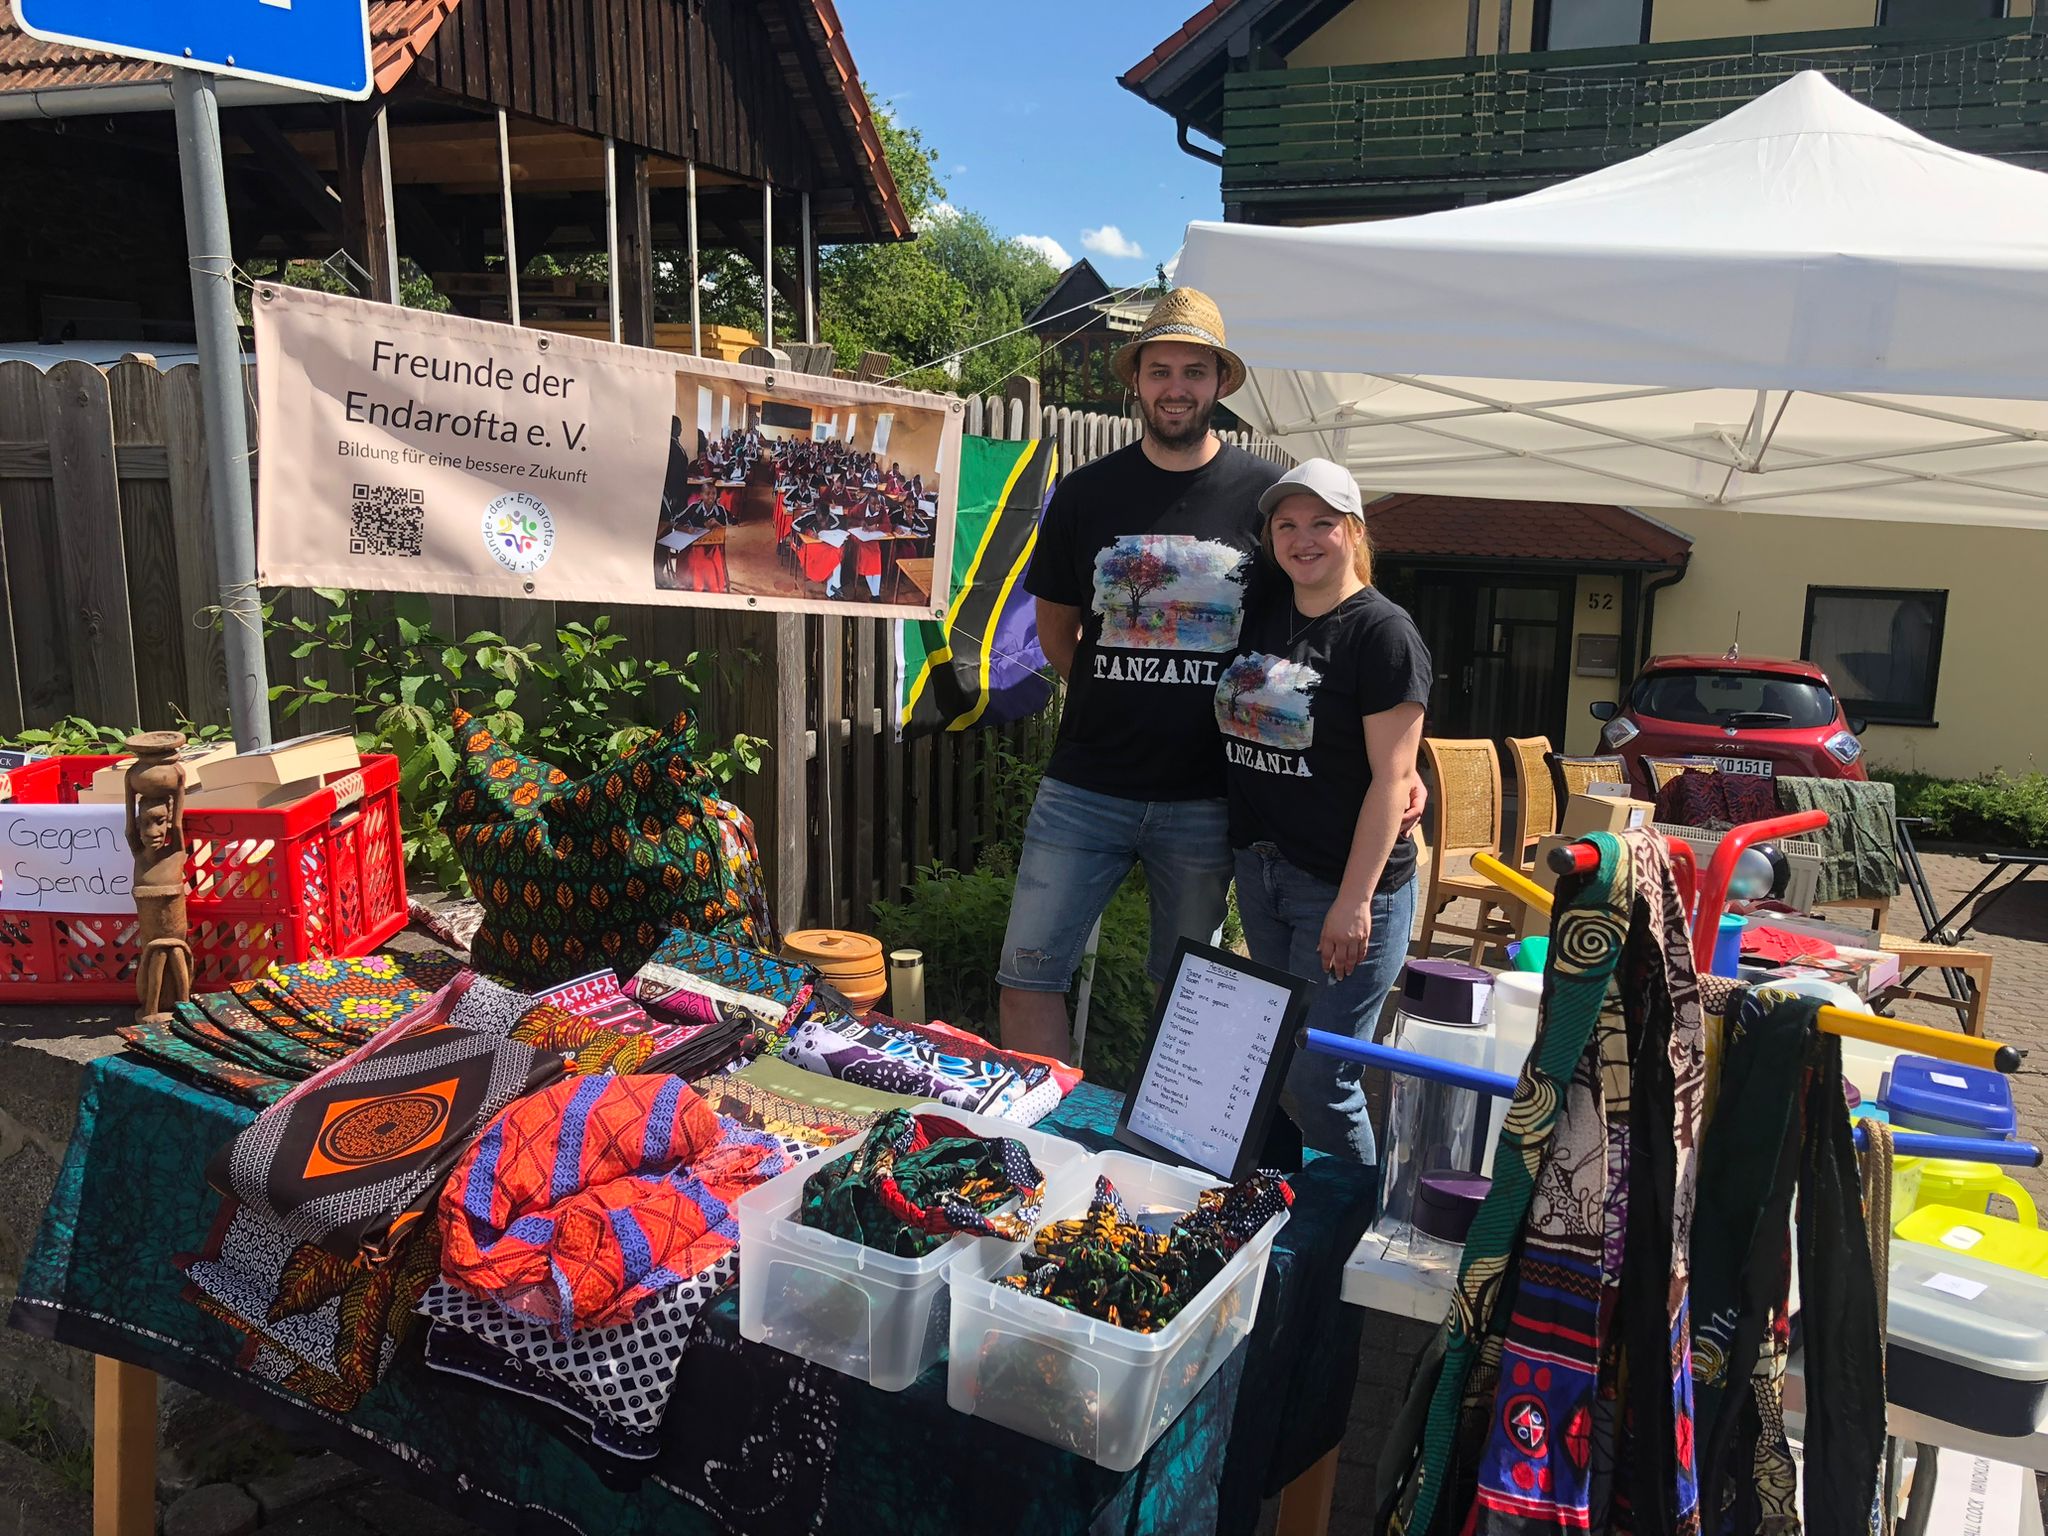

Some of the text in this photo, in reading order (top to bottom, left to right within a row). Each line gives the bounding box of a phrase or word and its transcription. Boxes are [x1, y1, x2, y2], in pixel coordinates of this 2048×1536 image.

[372, 340, 575, 399] Freunde der
[346, 390, 588, 452] Endarofta e. V.
[337, 441, 588, 484] Bildung für eine bessere Zukunft
[490, 497, 507, 514] der
[517, 493, 554, 547] Endarofta
[483, 522, 517, 570] Freunde
[1588, 593, 1613, 610] 52
[1093, 654, 1219, 686] TANZANI
[9, 818, 120, 864] Gegen
[15, 861, 130, 906] Spende
